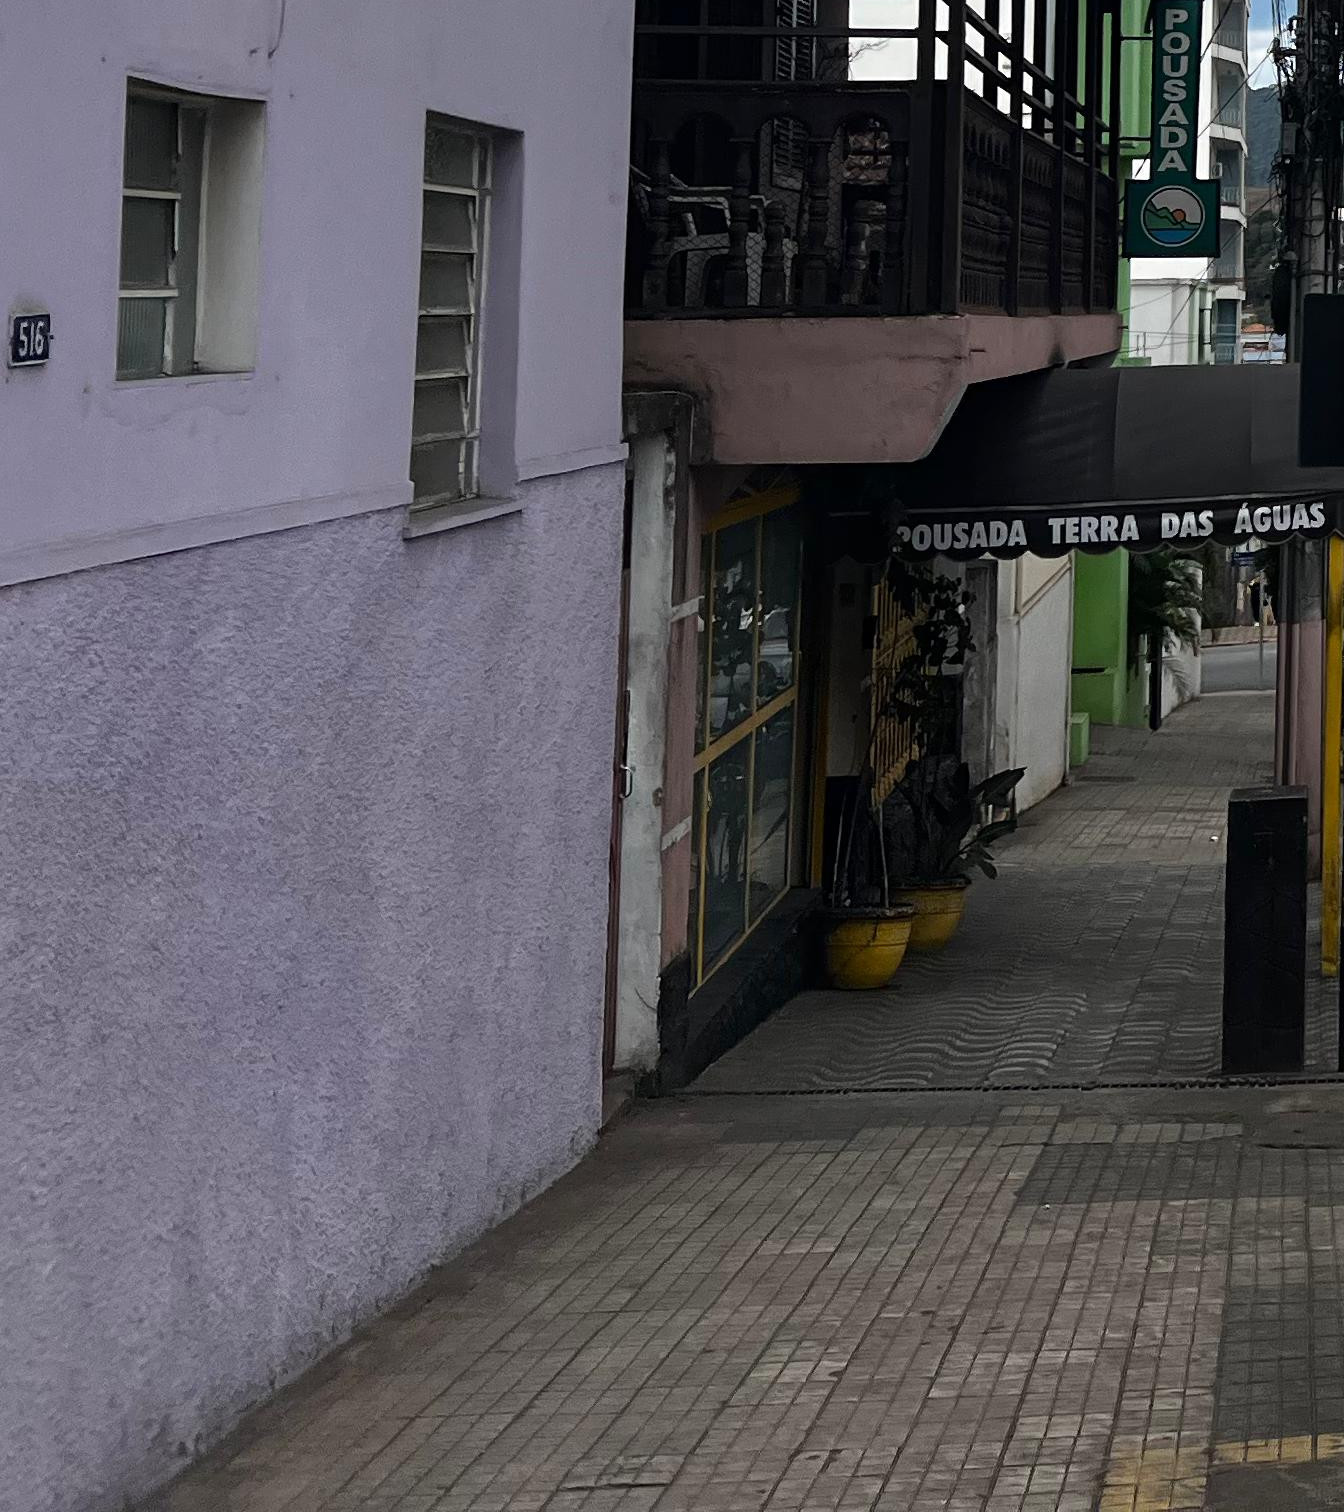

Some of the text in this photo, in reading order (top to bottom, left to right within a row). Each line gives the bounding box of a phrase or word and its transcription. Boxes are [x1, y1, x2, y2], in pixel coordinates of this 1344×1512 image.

[1157, 8, 1191, 172] POUSADA
[18, 320, 45, 357] 516
[1048, 514, 1140, 545] TERRA
[1161, 509, 1214, 539] DAS
[1234, 502, 1327, 534] ÁGUAS
